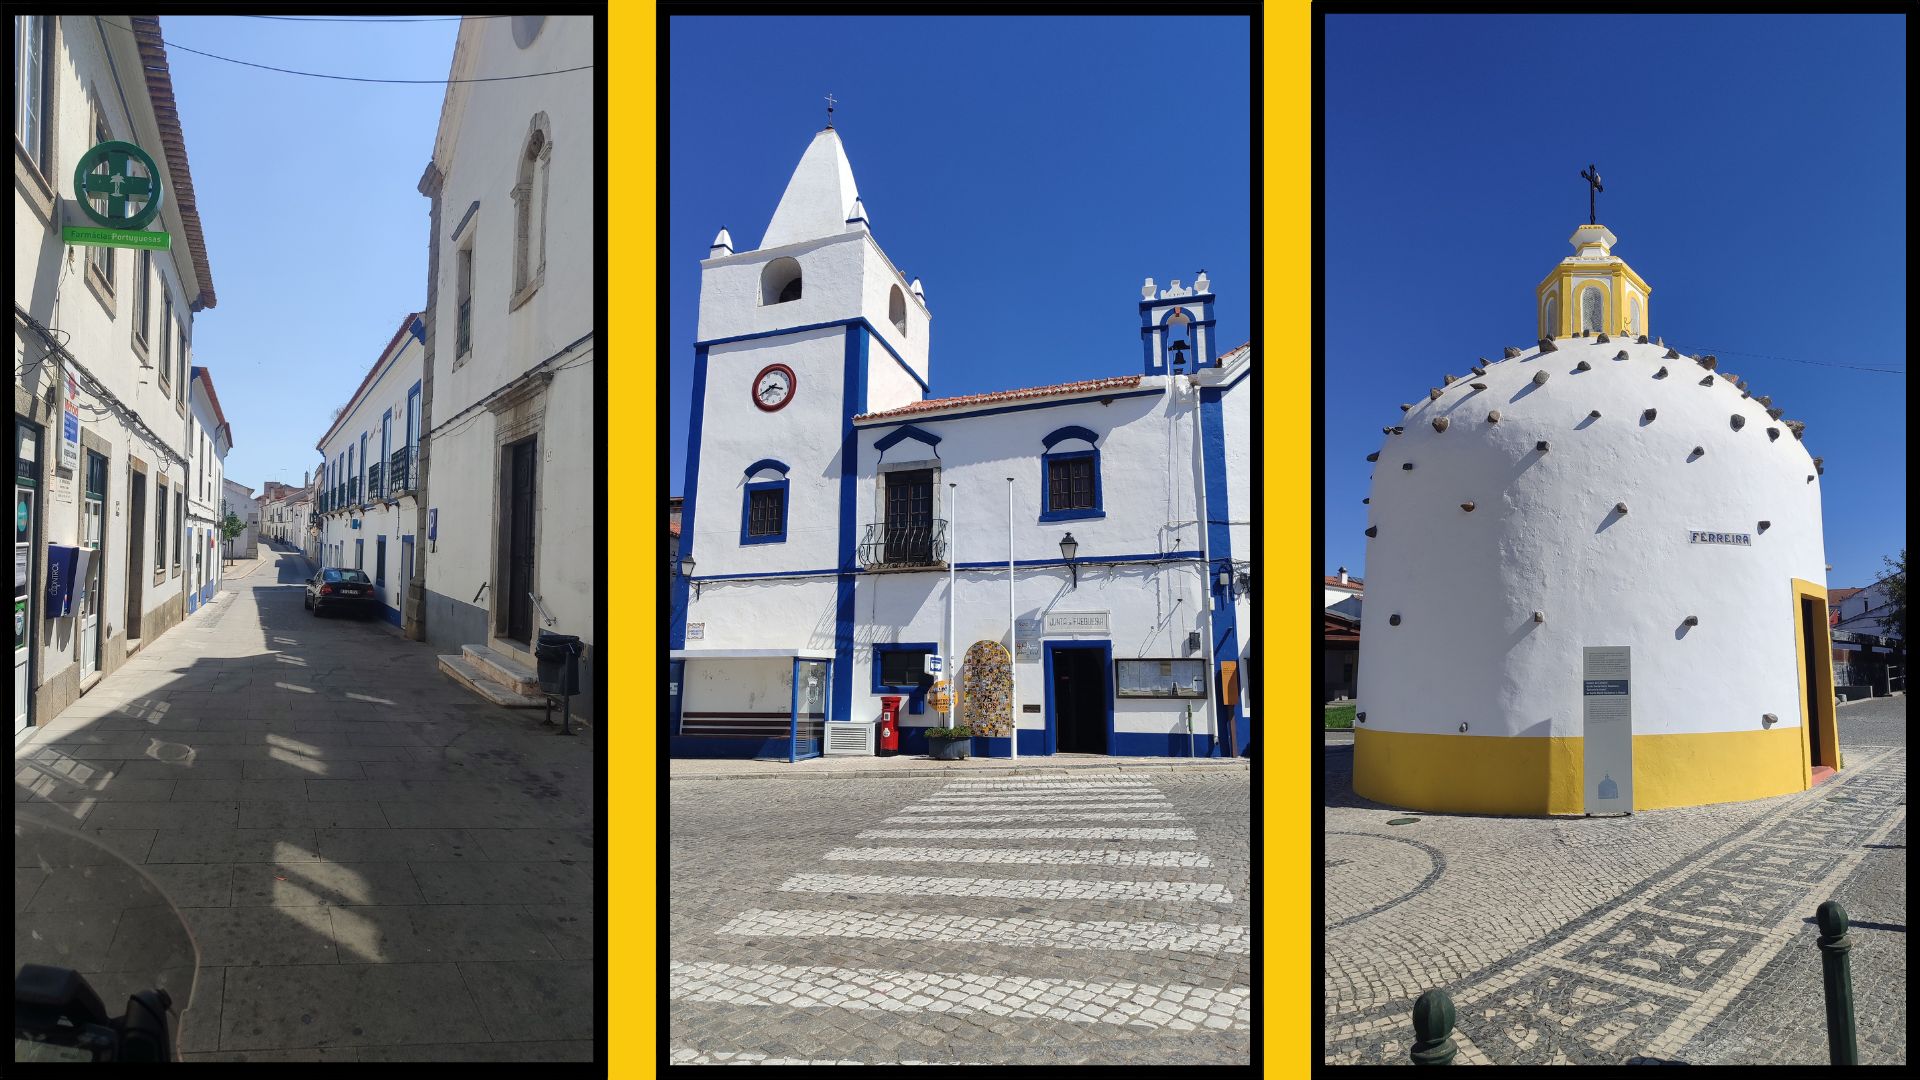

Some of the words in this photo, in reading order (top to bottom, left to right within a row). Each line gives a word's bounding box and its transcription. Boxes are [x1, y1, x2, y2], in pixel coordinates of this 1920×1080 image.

[430, 511, 435, 537] P
[1692, 532, 1749, 544] FERREIRA
[50, 562, 60, 596] CONTROL
